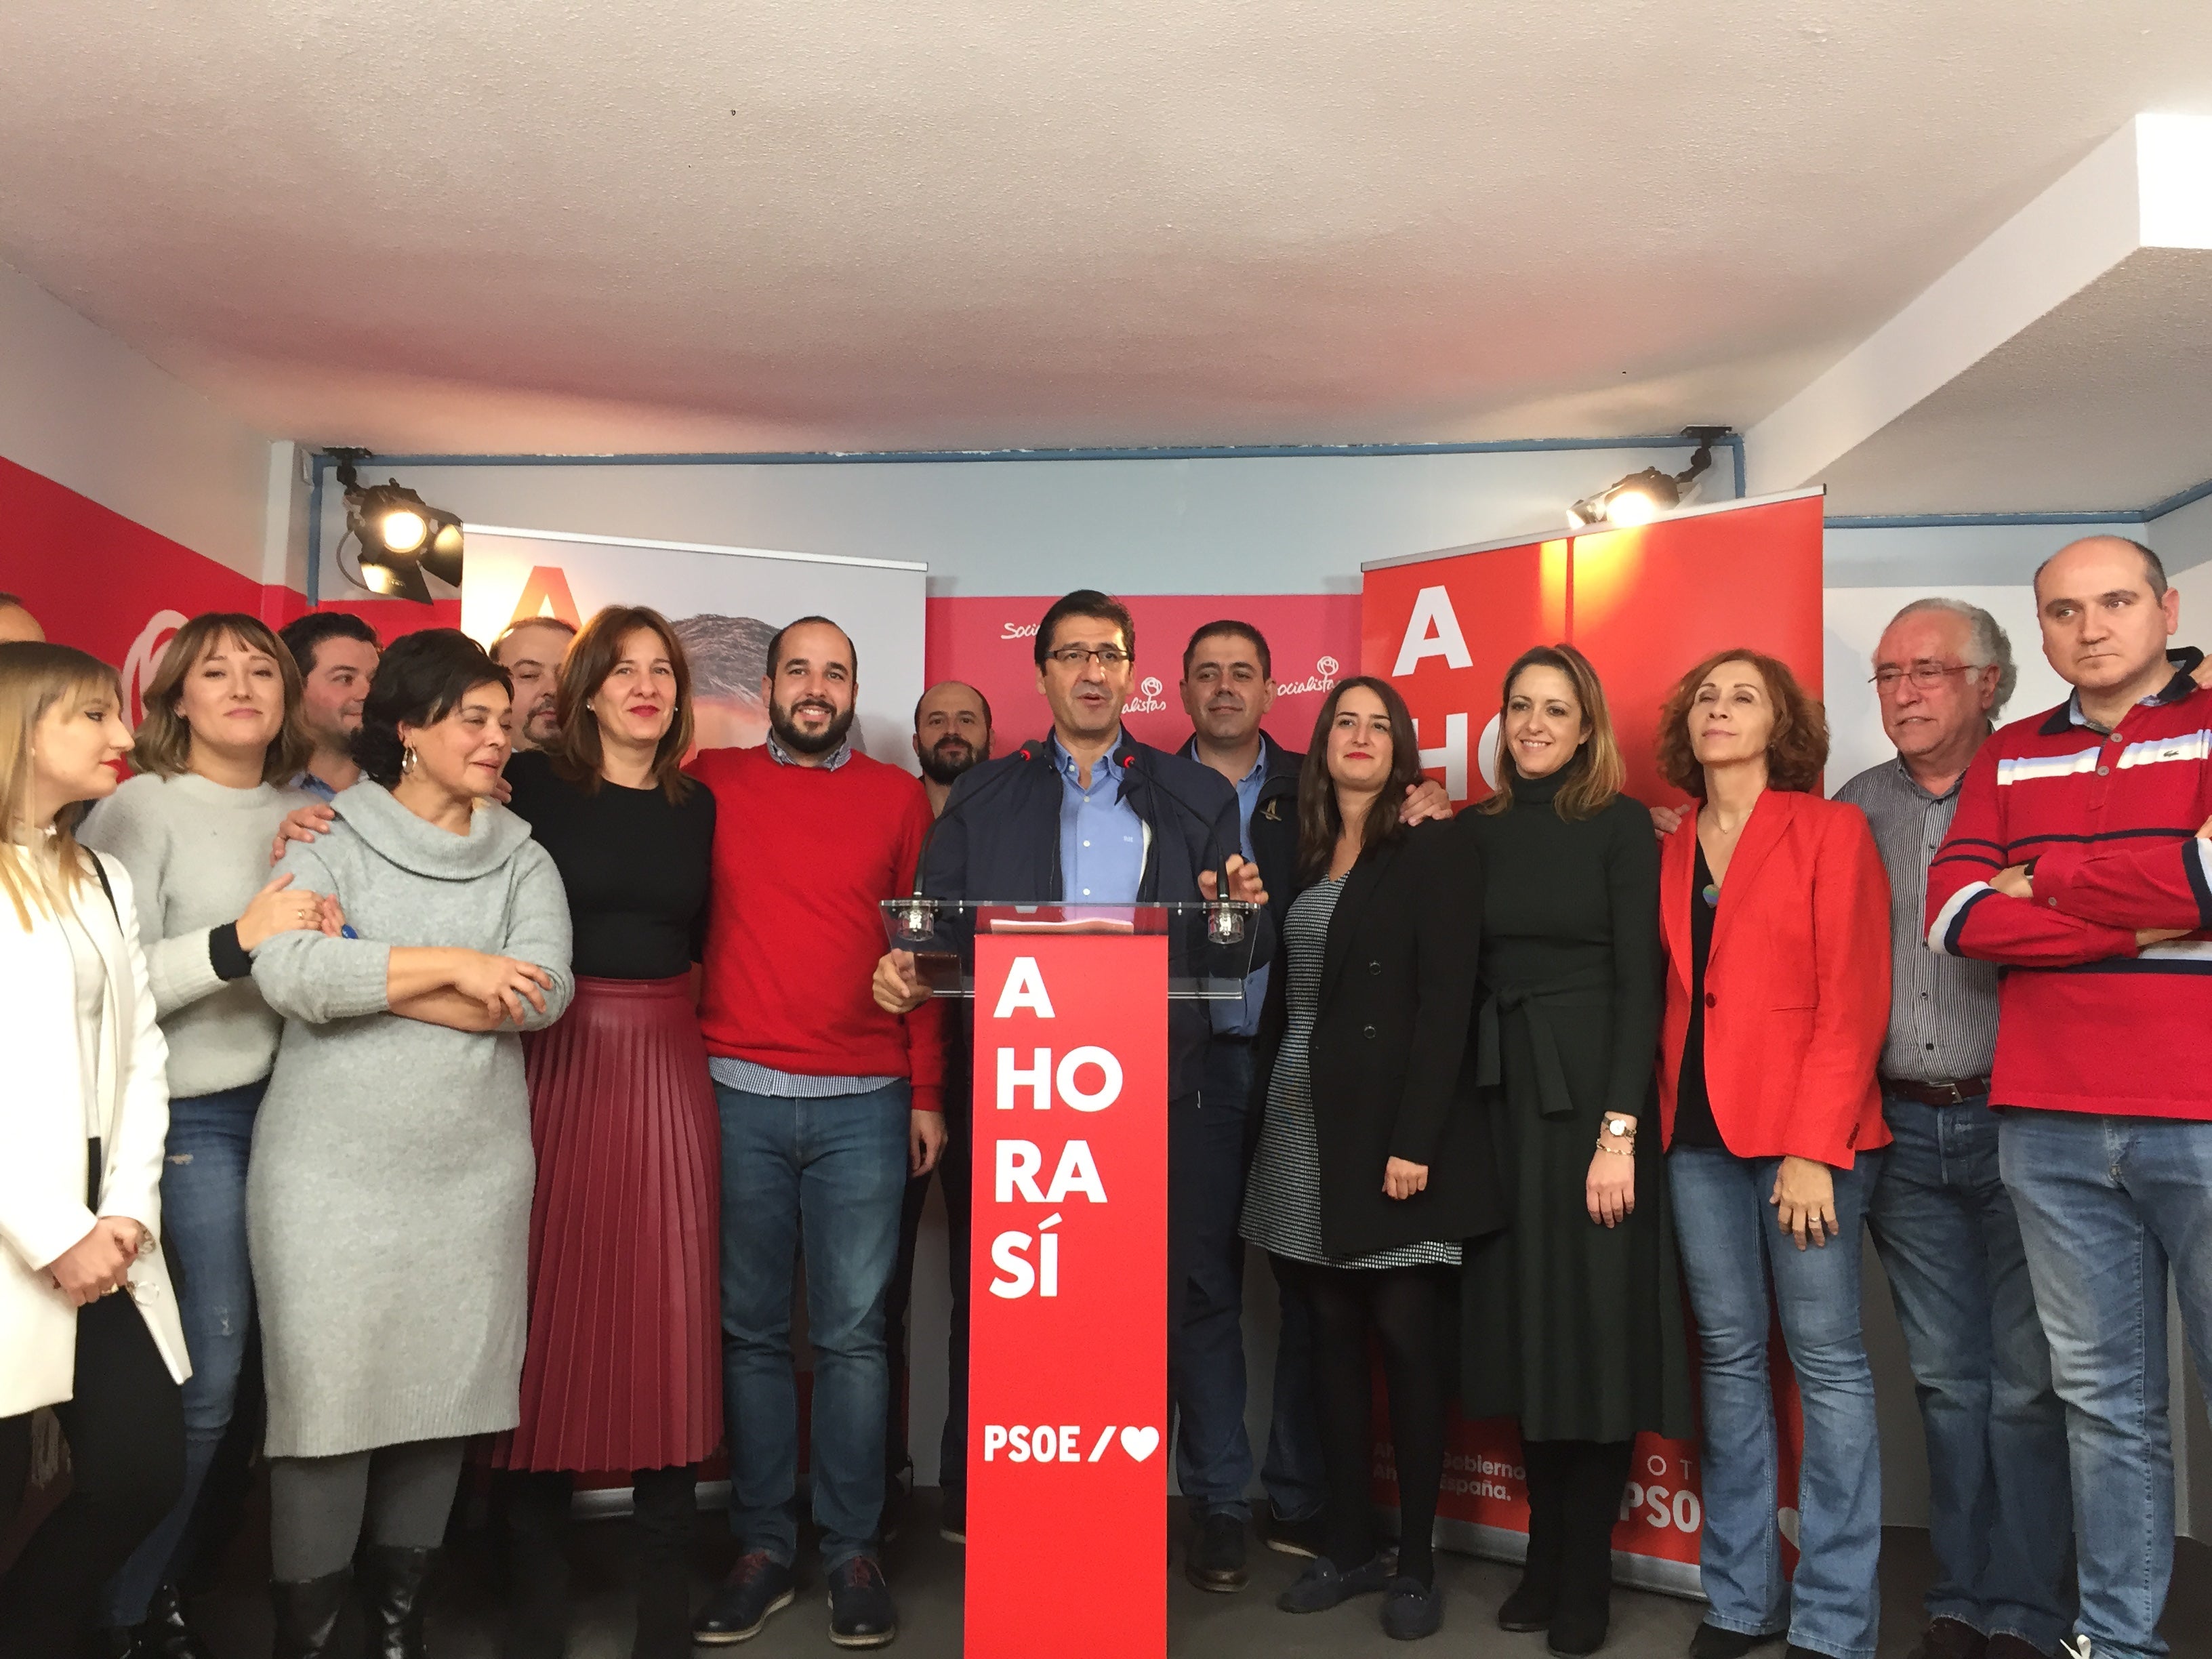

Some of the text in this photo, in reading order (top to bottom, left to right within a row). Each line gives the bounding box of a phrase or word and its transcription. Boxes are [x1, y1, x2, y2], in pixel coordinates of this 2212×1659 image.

[1391, 584, 1473, 677] A
[1122, 694, 1166, 714] alistas
[1277, 676, 1340, 697] ocialista
[993, 956, 1056, 1018] A
[996, 1045, 1124, 1113] HO
[995, 1139, 1108, 1203] RA
[988, 1212, 1063, 1299] SÍ
[984, 1425, 1081, 1463] PSOE
[1620, 1481, 1701, 1533] PSO
